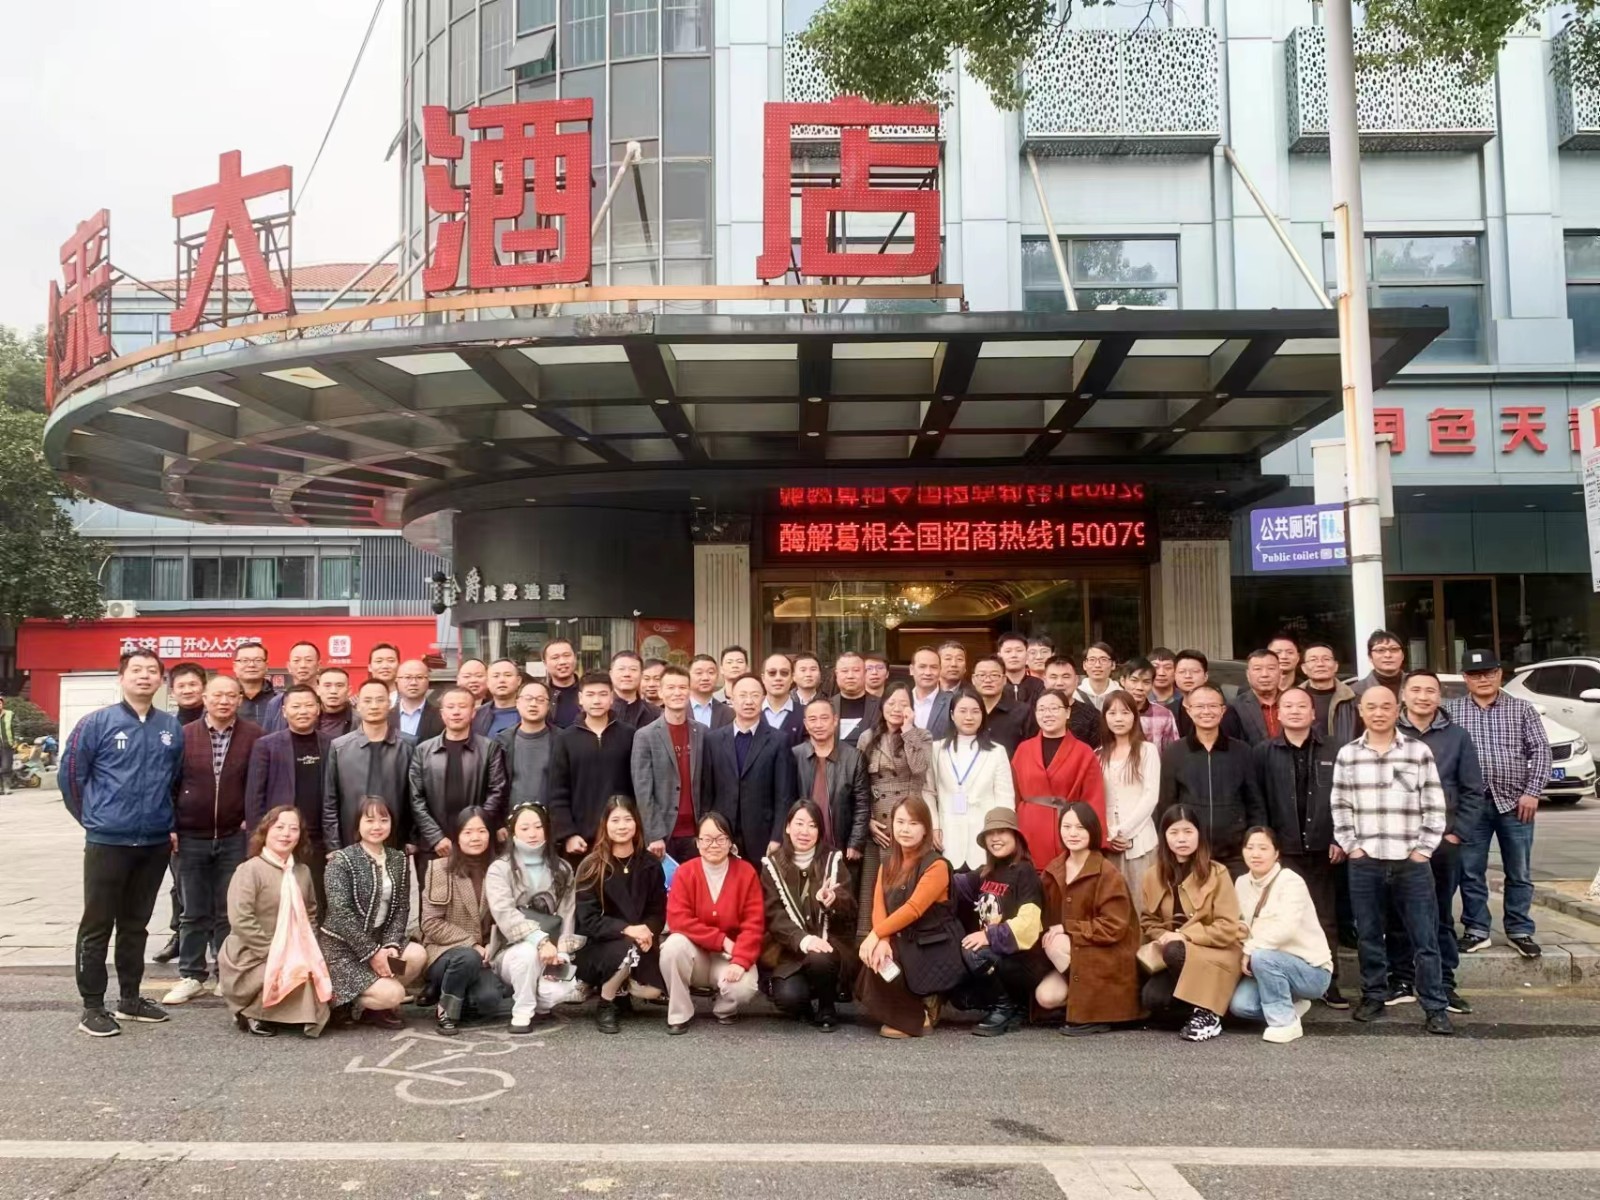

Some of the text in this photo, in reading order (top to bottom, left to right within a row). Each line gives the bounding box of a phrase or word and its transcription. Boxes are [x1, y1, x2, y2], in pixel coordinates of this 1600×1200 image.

[1373, 406, 1581, 454] 国色天
[779, 519, 1145, 552] 酶解葛根全国招商热线150079
[1260, 514, 1318, 541] 公共厕所
[1262, 550, 1319, 563] Public toilet
